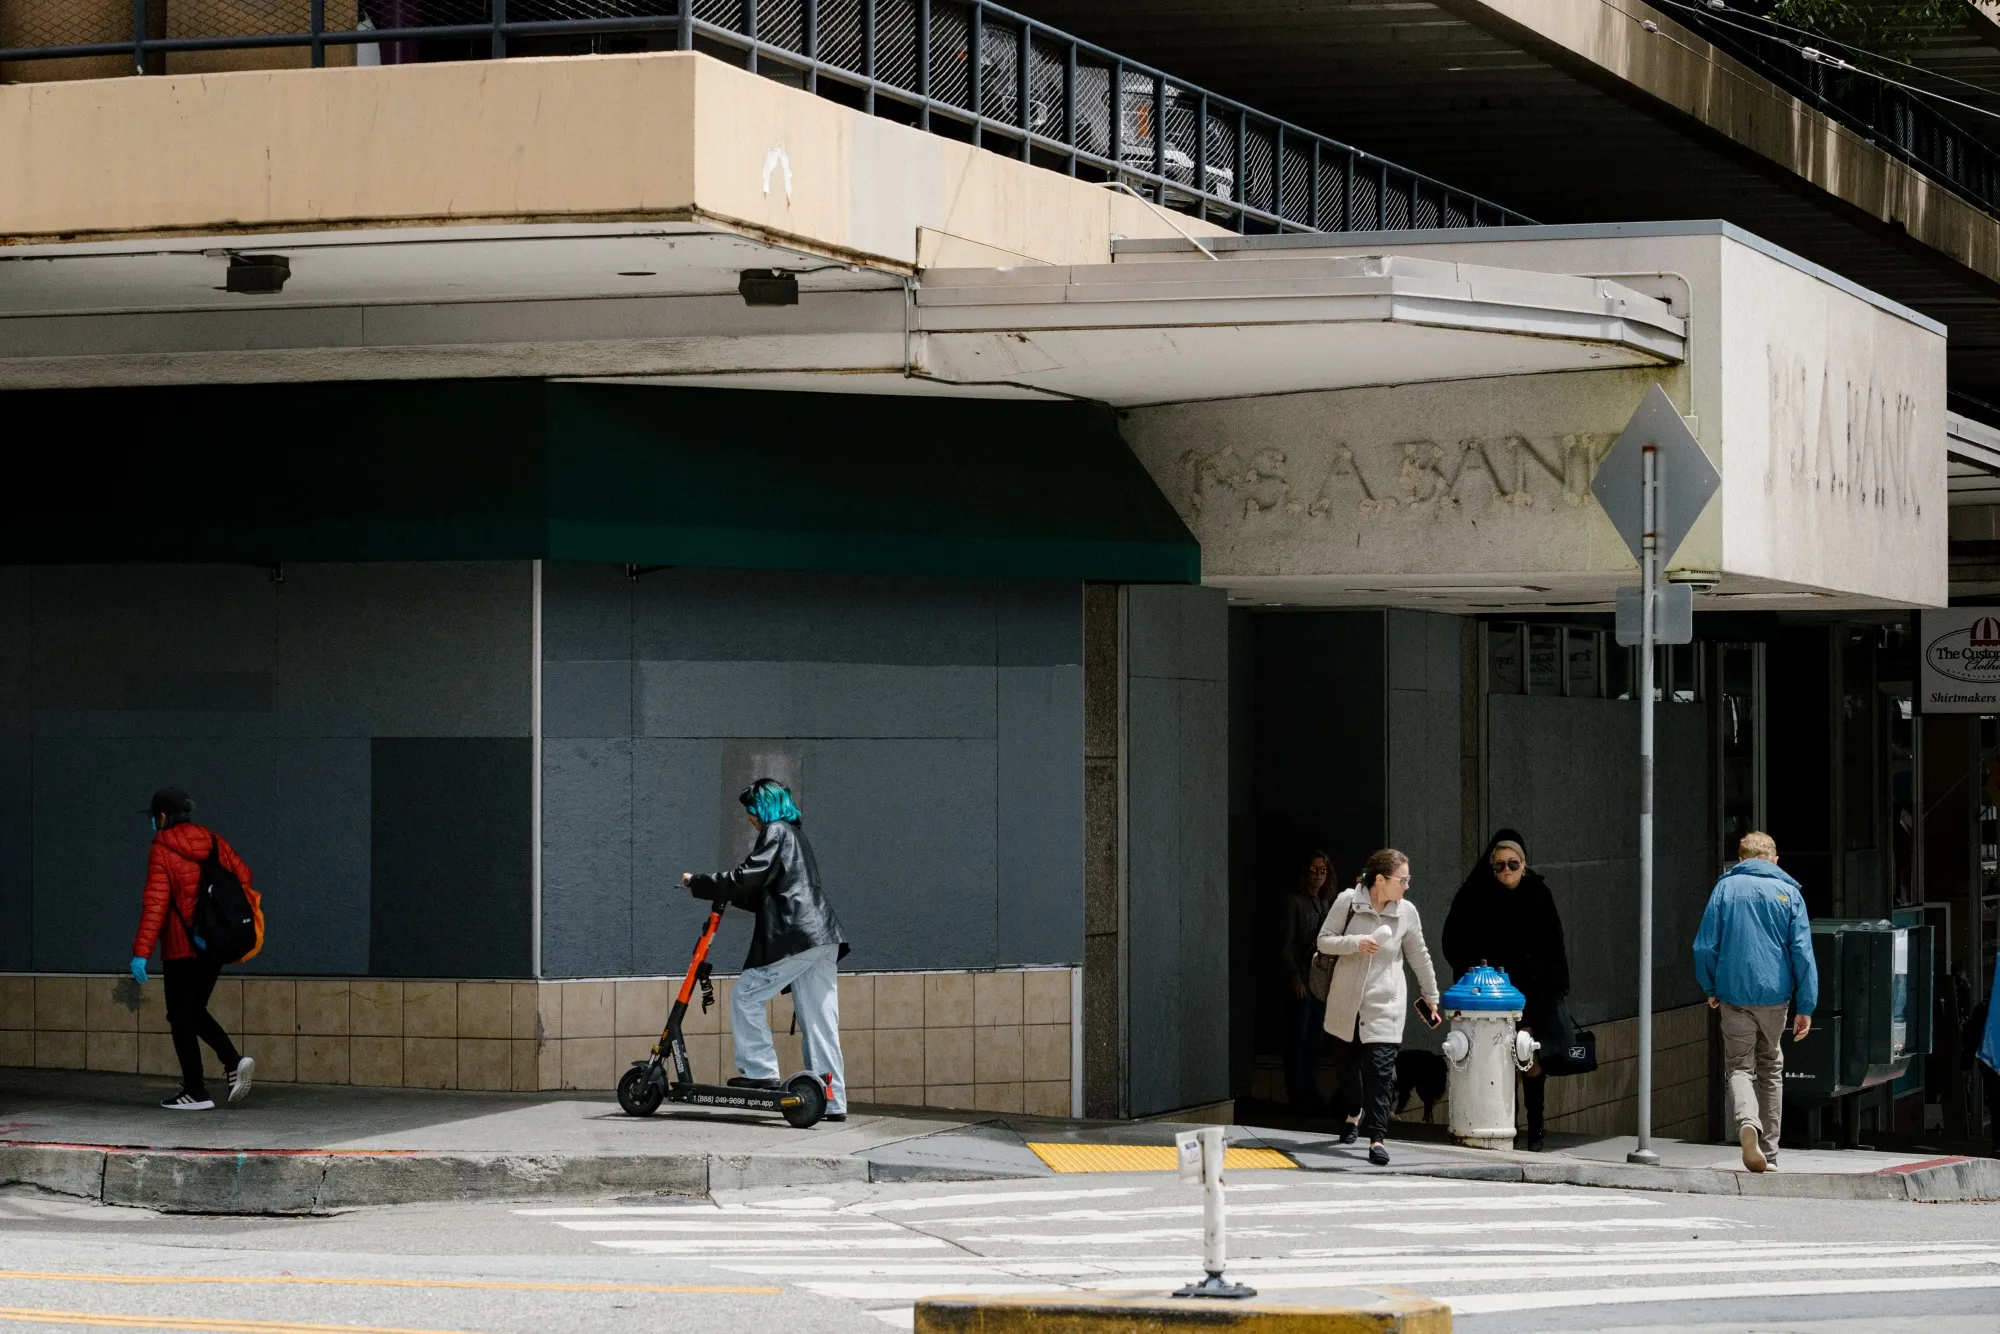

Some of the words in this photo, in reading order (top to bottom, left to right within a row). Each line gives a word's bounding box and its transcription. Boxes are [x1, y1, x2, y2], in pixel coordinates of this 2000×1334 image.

[1936, 647, 1960, 659] The
[1931, 692, 1997, 703] Shirtmakers
[698, 1095, 714, 1104] (888)
[747, 1099, 774, 1107] spin.app
